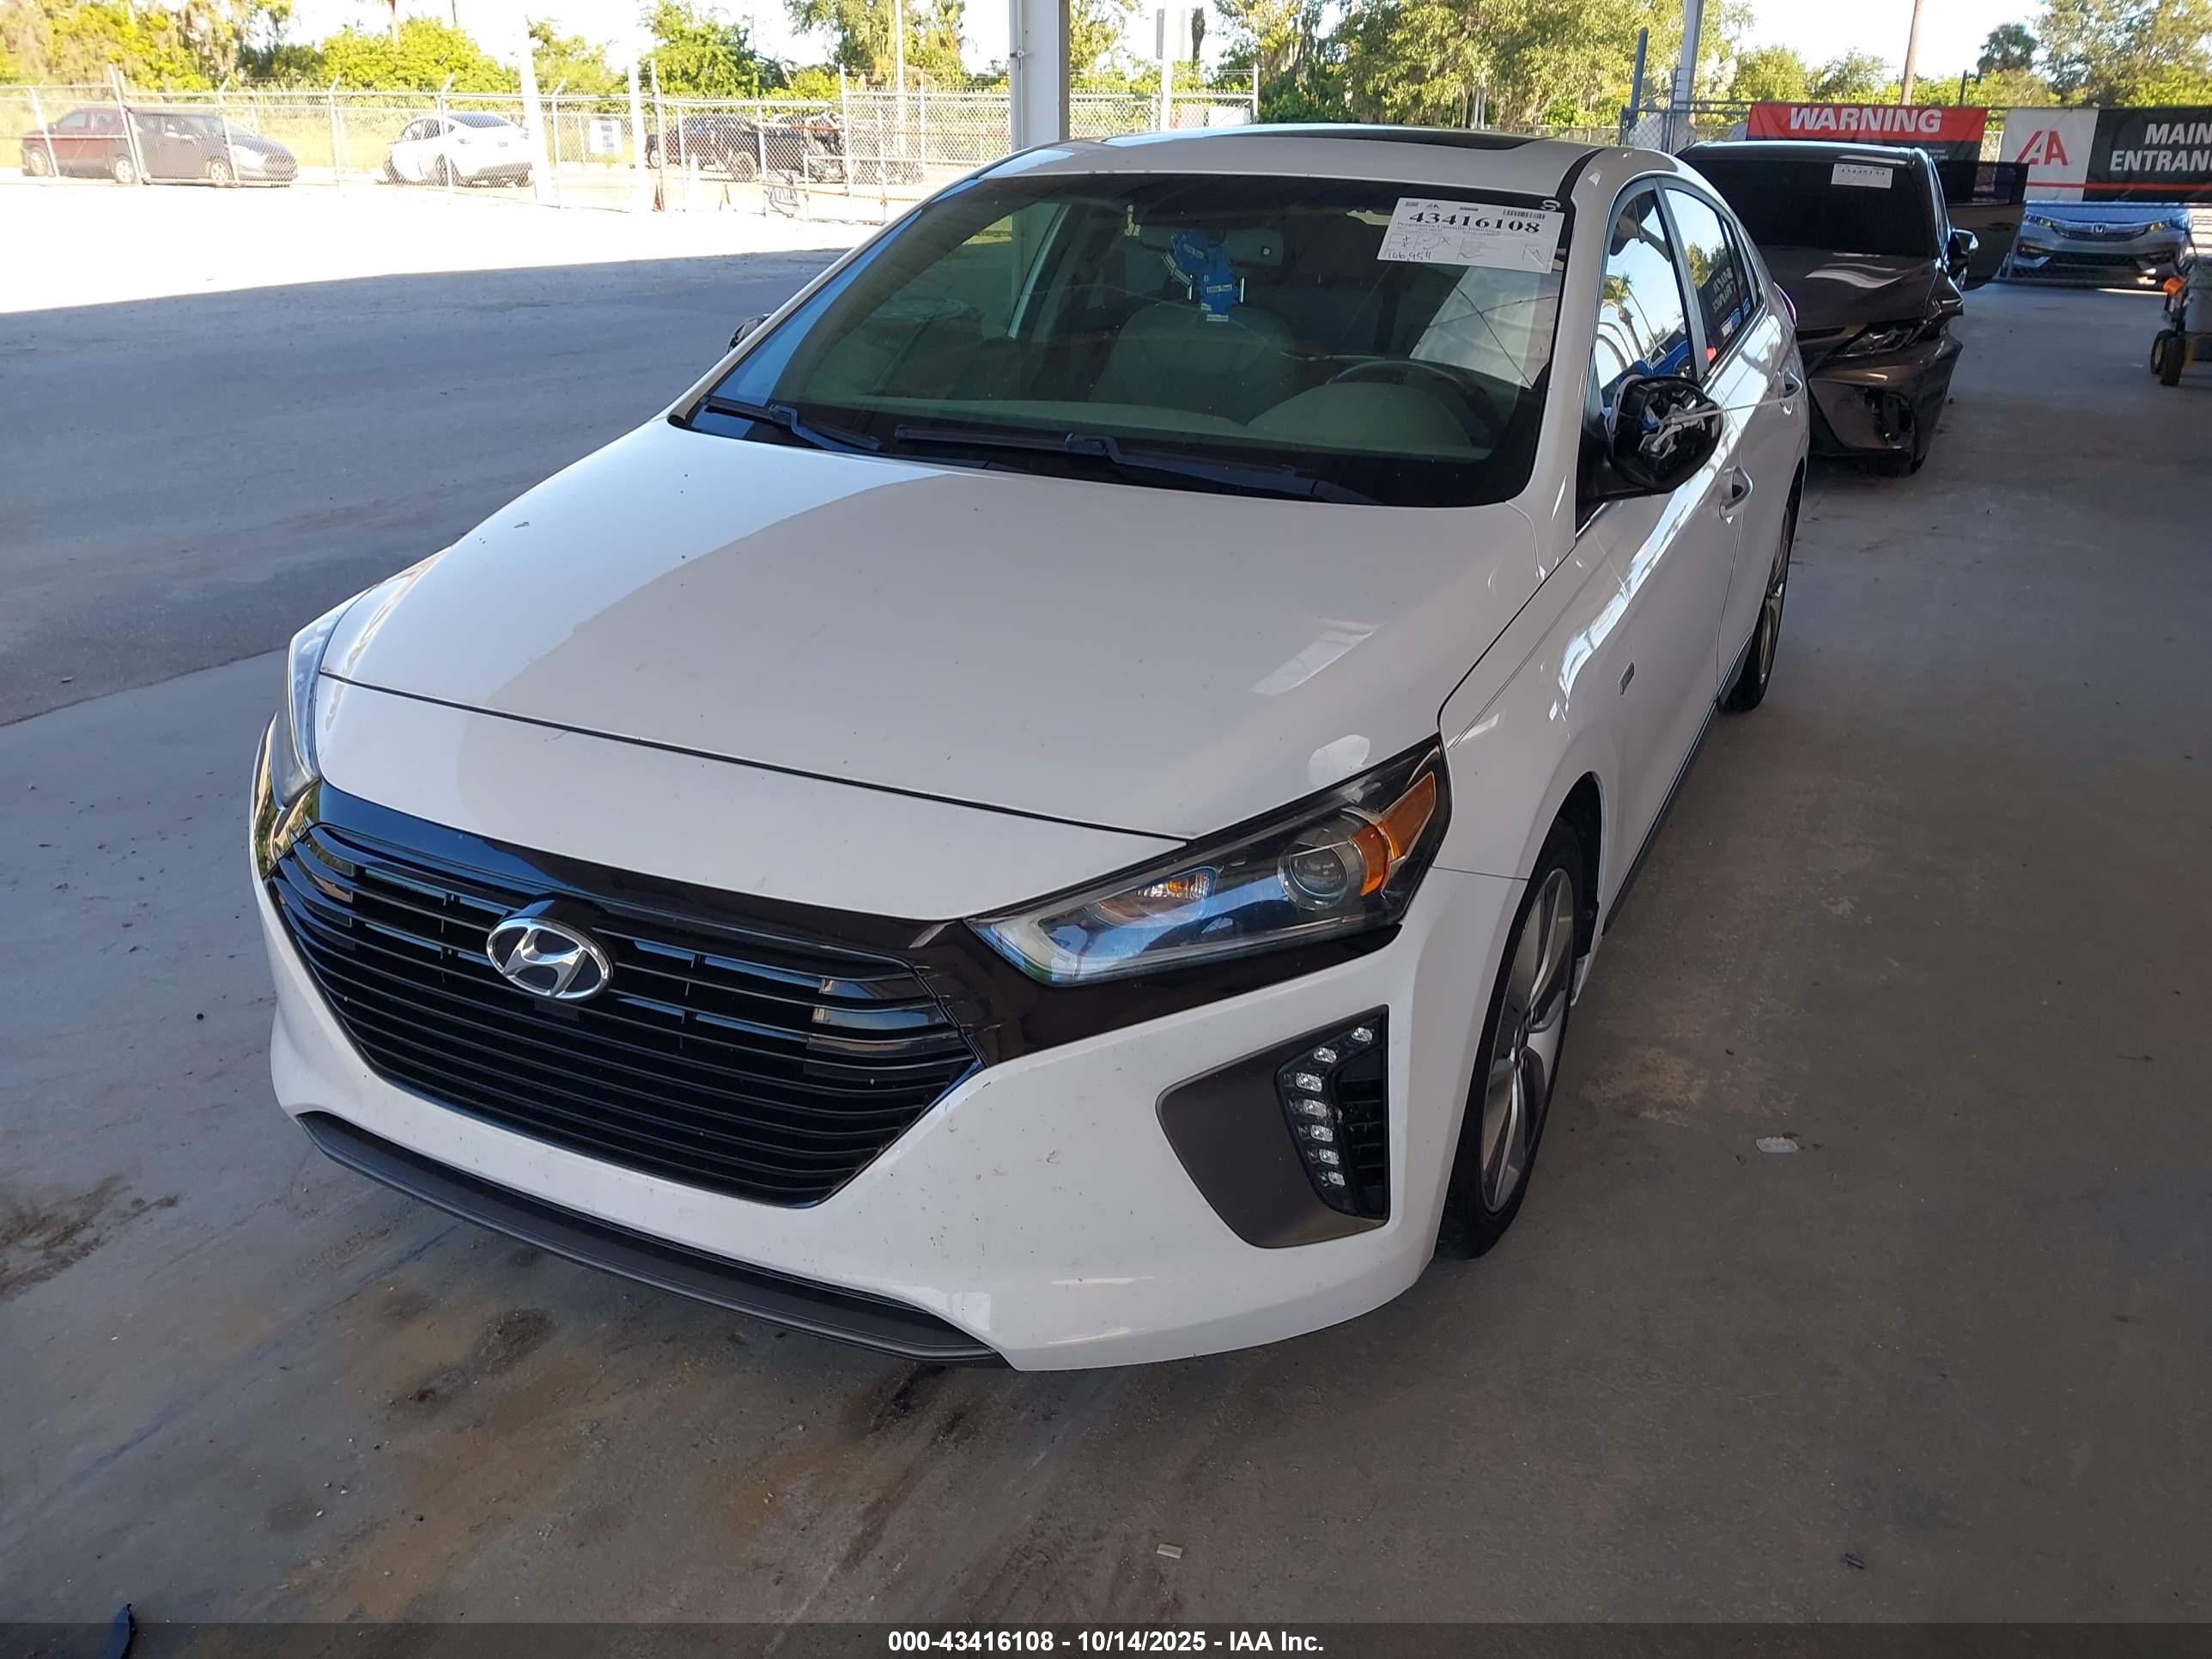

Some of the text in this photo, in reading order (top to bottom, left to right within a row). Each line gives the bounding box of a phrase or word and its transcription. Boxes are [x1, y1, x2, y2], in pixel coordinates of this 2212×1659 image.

[1790, 106, 1942, 133] WARNING
[2144, 123, 2212, 145] MAIN
[2109, 149, 2212, 172] ENTRAN
[1409, 210, 1541, 234] 43416108
